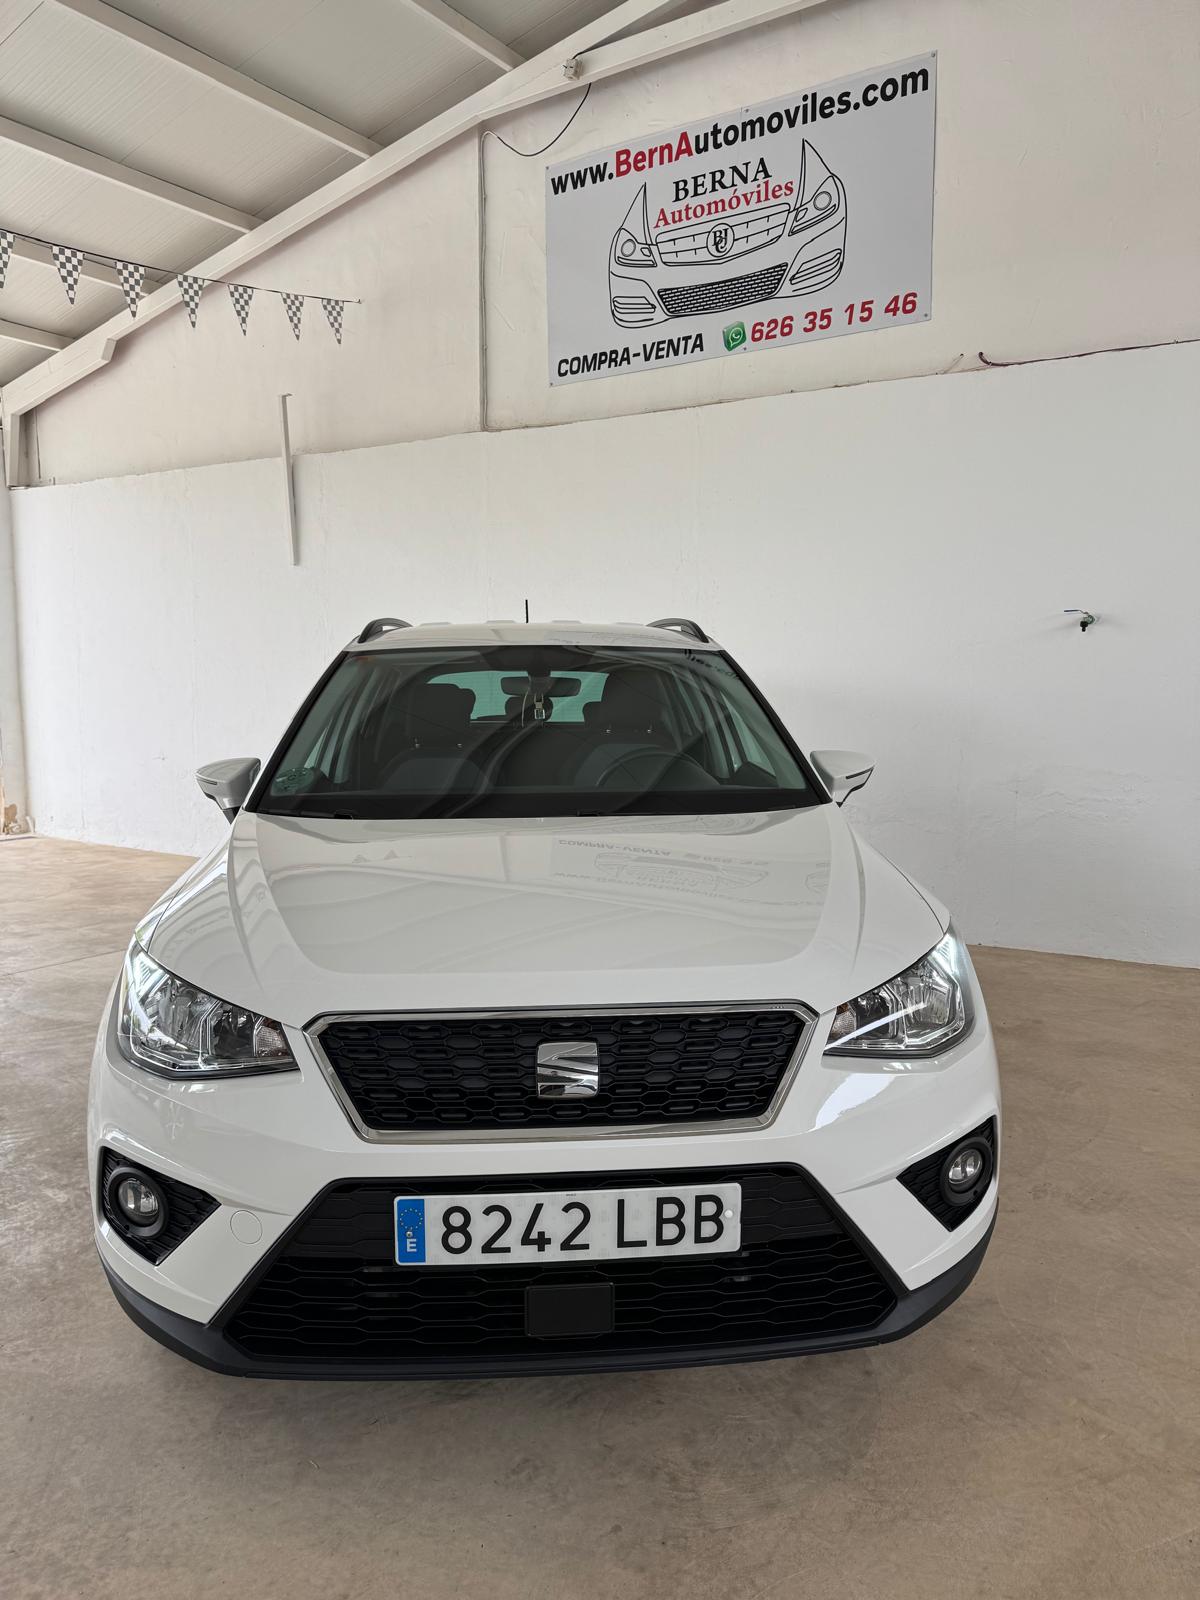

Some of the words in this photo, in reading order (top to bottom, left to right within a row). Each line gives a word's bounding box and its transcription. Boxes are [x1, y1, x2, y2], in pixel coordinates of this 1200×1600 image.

[550, 68, 929, 196] www.BernAutomoviles.com
[653, 180, 795, 229] Automóviles
[672, 157, 773, 203] BERNA
[750, 315, 794, 343] 626
[802, 307, 833, 333] 35
[844, 299, 874, 326] 15
[883, 291, 918, 317] 46
[557, 333, 704, 377] COMPRA-VENTA
[406, 1238, 417, 1252] E
[440, 1202, 592, 1255] 8242
[616, 1194, 725, 1249] LBB
